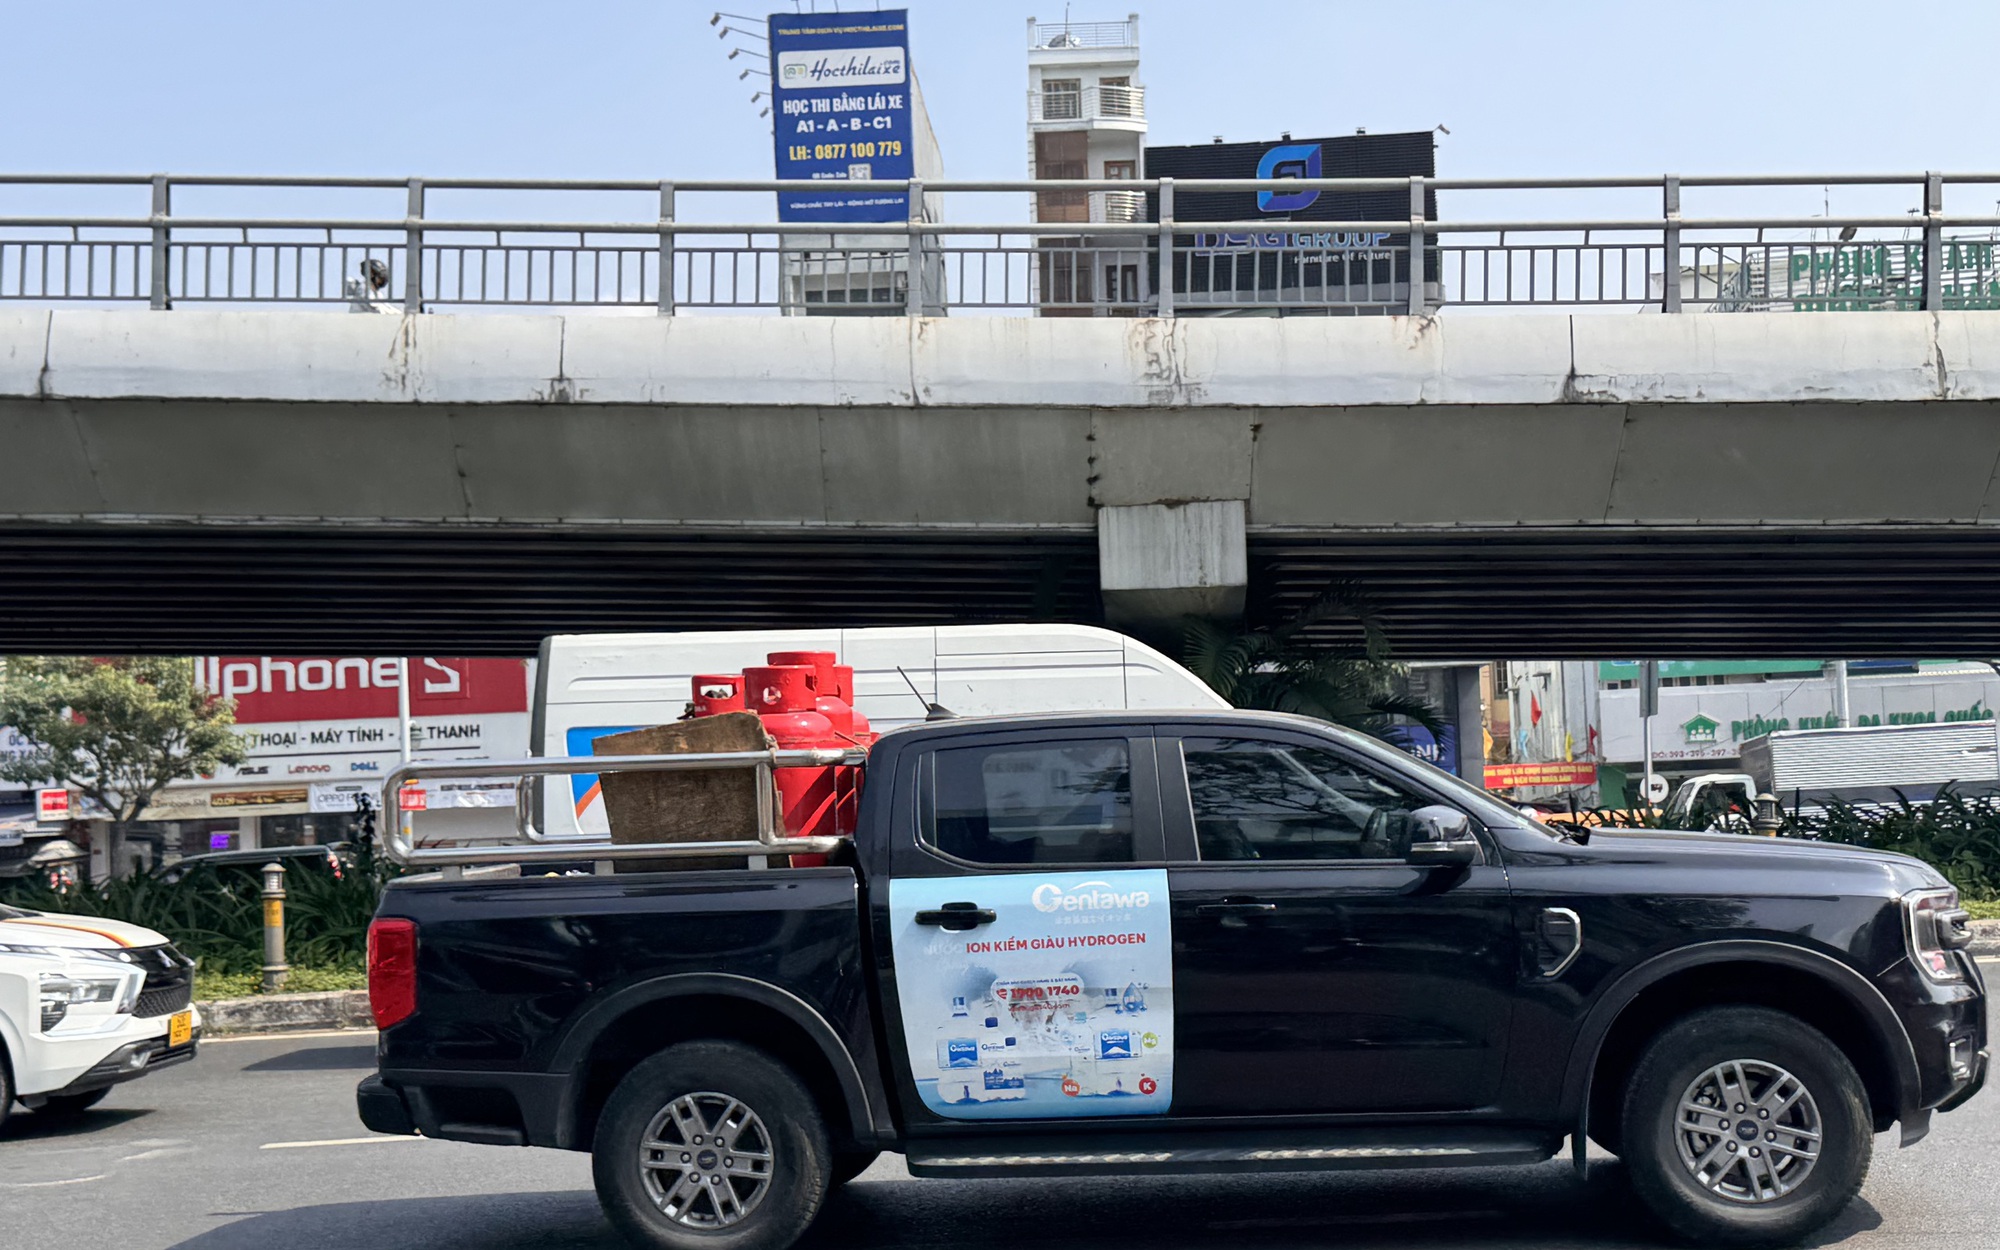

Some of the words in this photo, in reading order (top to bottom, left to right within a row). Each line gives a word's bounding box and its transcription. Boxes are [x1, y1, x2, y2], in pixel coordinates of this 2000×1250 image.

[810, 55, 900, 81] Hocthilaixe
[783, 99, 809, 116] HỌC
[810, 98, 831, 113] THI
[832, 92, 866, 112] BẰNG
[867, 92, 886, 110] LÁI
[888, 95, 903, 109] XE
[796, 119, 815, 133] A1
[826, 118, 839, 132] A
[850, 117, 862, 131] B
[872, 116, 892, 129] C1
[789, 145, 812, 161] LH:
[814, 143, 847, 160] 0877
[850, 142, 875, 158] 100
[878, 140, 902, 157] 779
[1292, 231, 1391, 248] GROUP
[1799, 711, 1838, 730] KHÁ
[311, 727, 344, 745] MÁY
[347, 725, 384, 743] TÍNH
[427, 724, 480, 739] THANH
[288, 764, 331, 774] Lenovo
[1032, 883, 1150, 912] Gentawa
[966, 942, 991, 953] ION
[1030, 935, 1065, 950] GIÀU
[1068, 933, 1146, 948] HYDROGEN
[1047, 985, 1080, 996] 1740
[1143, 1082, 1152, 1090] K
